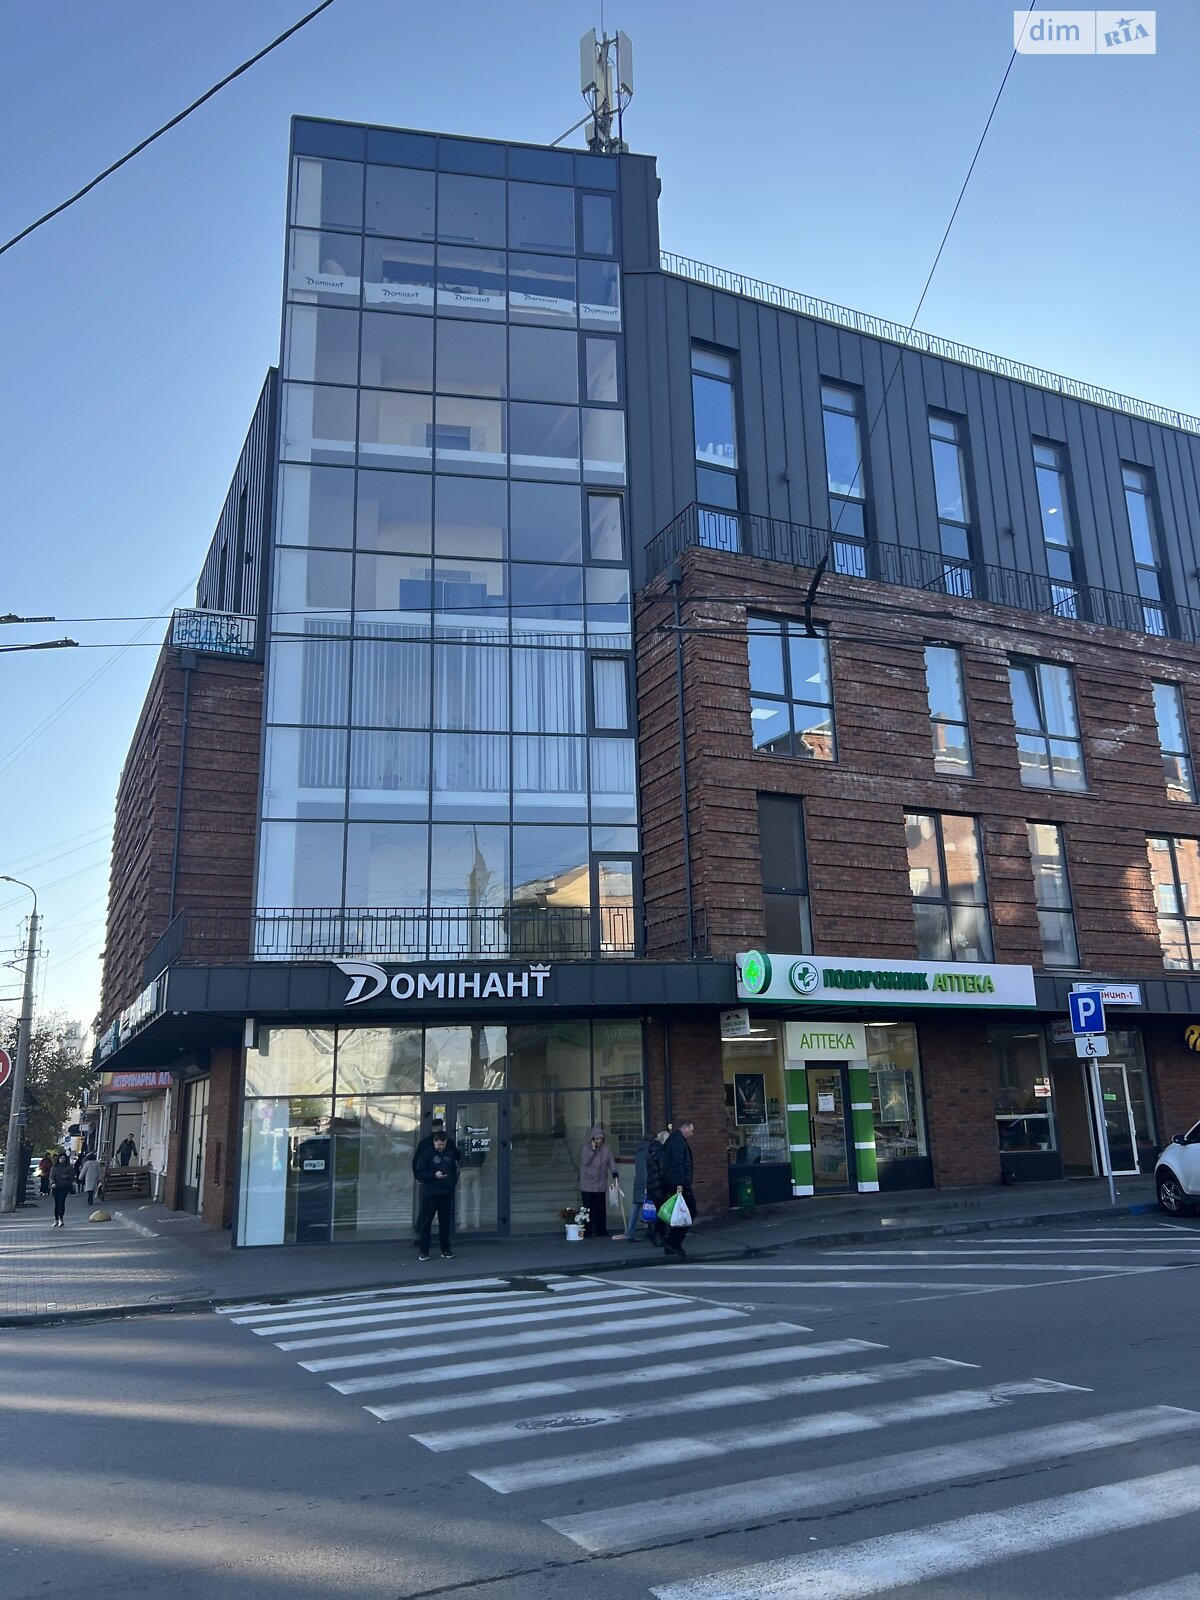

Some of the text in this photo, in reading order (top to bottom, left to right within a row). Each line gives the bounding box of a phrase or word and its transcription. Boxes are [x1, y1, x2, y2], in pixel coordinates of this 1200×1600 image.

[822, 968, 996, 993] ПОДОРОЖНИК АПТЕКА
[1077, 997, 1096, 1027] P
[800, 1033, 856, 1050] АПТЕКА
